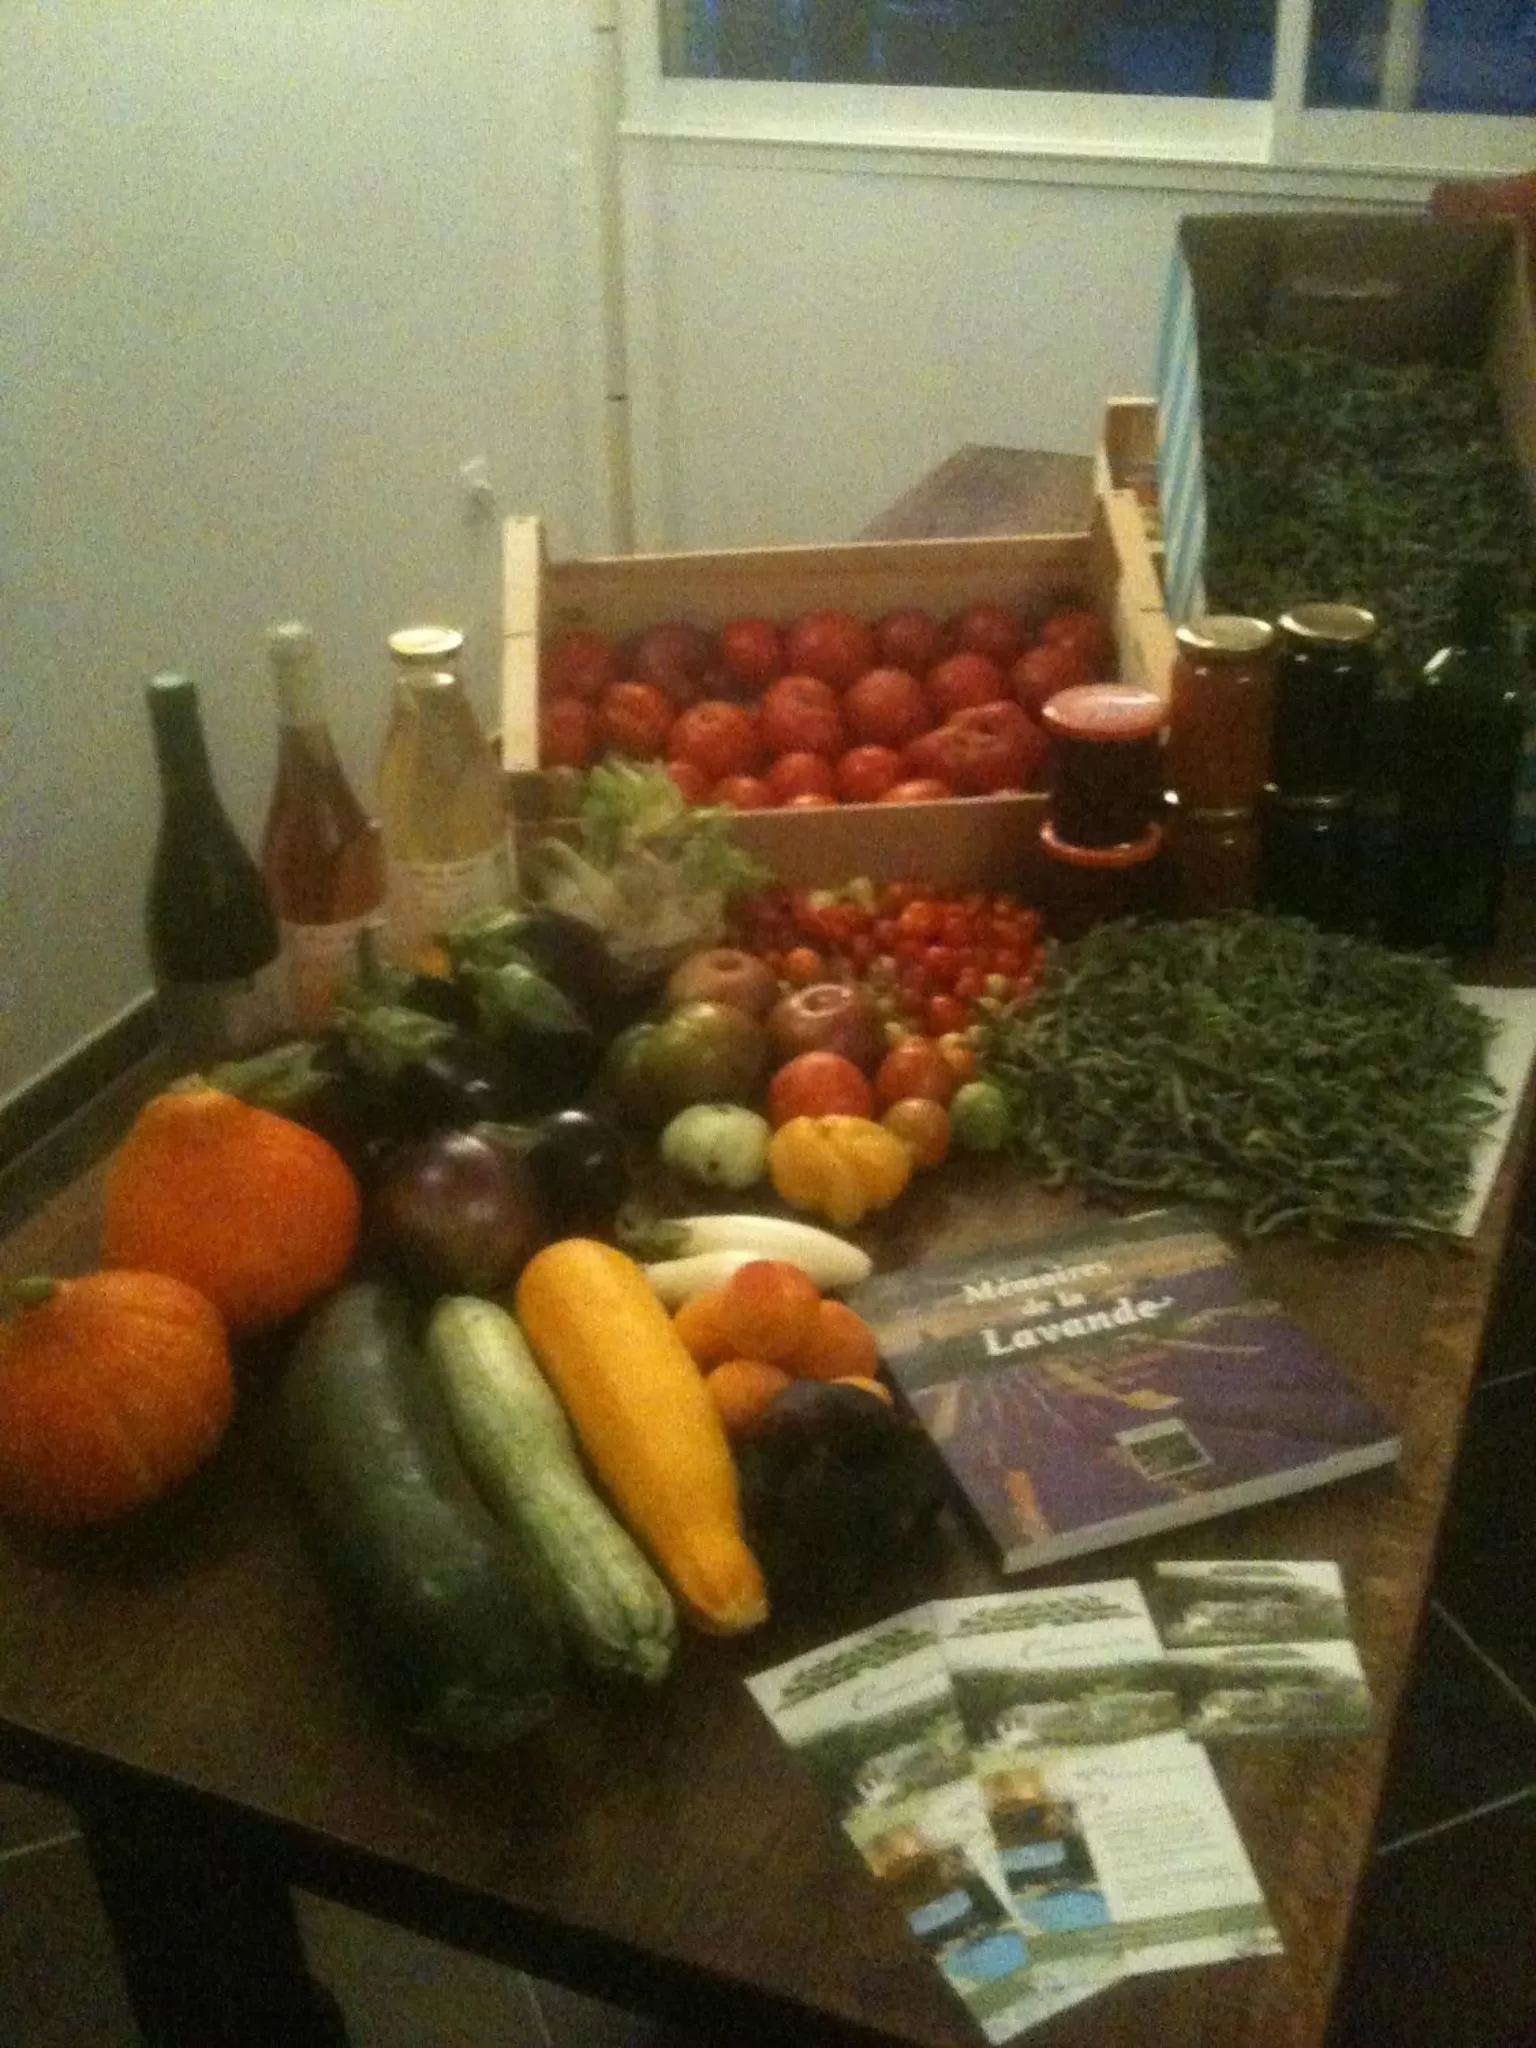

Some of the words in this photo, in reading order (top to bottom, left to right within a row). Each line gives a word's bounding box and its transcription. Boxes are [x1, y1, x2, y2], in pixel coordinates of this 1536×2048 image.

[1020, 1299, 1053, 1317] de
[1055, 1291, 1087, 1307] la
[981, 1296, 1175, 1356] Lavande
